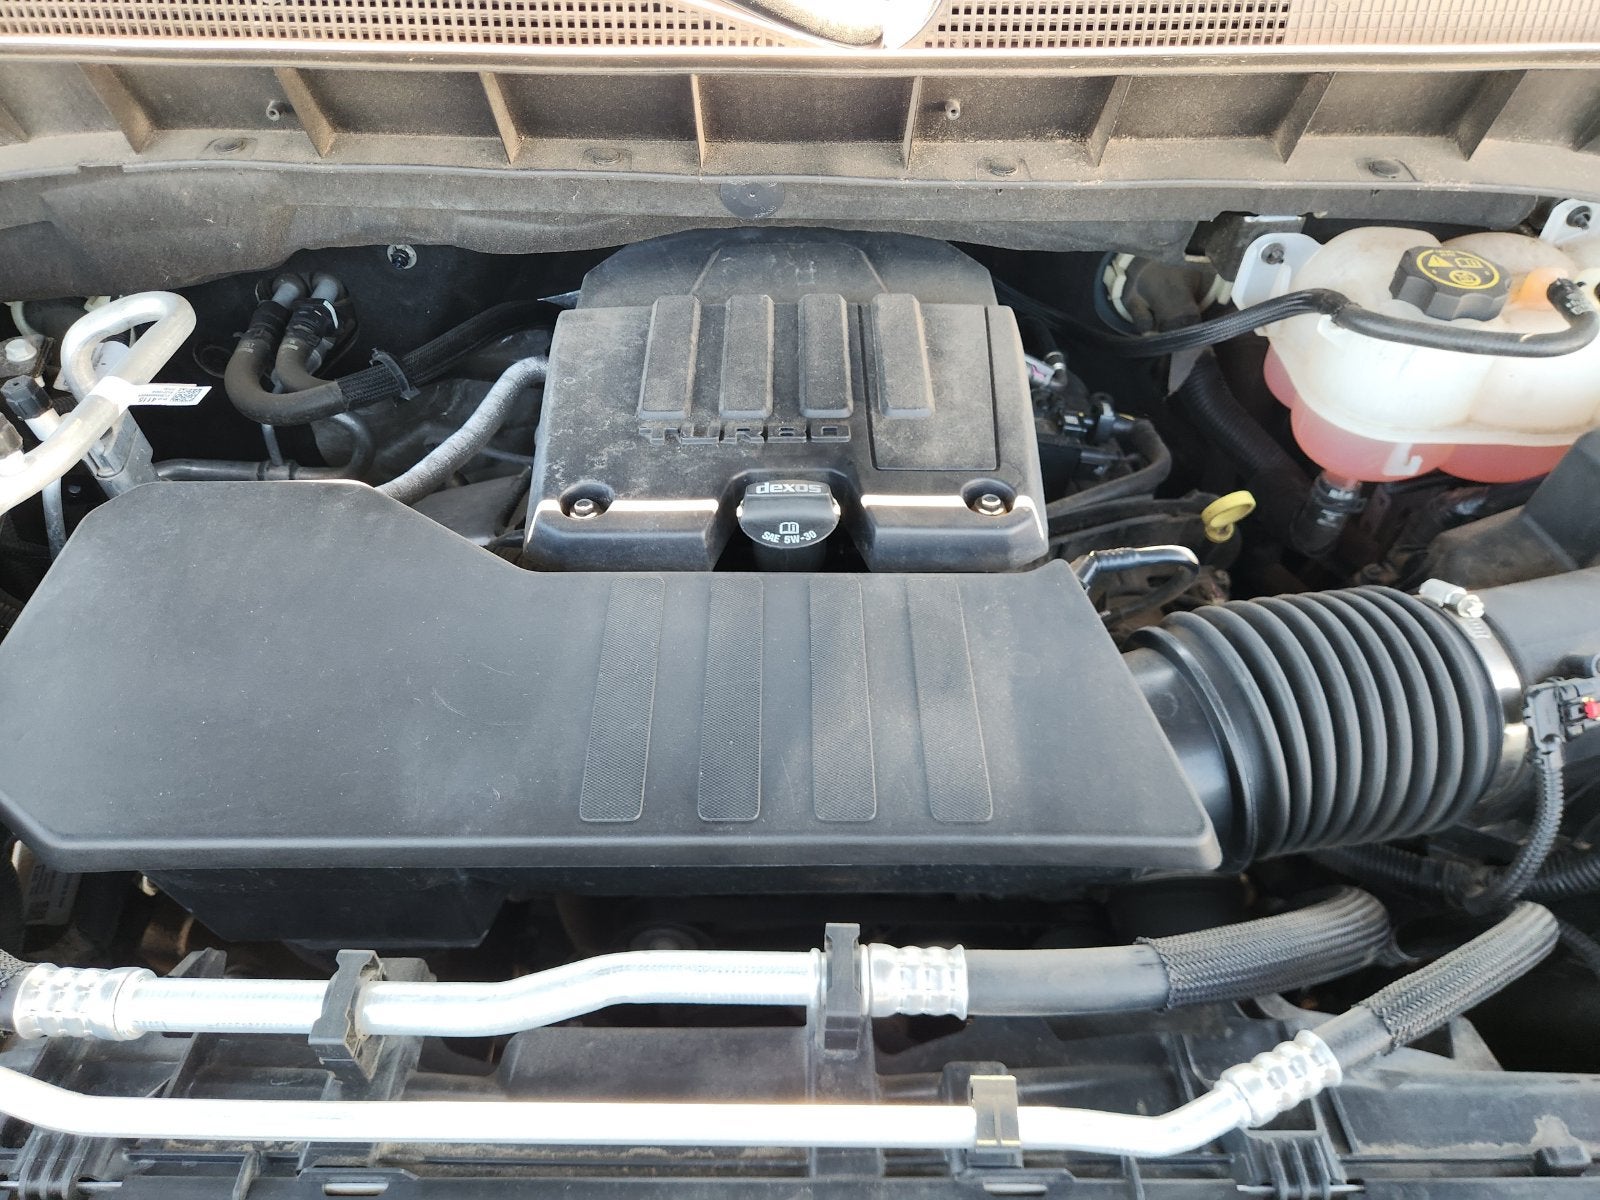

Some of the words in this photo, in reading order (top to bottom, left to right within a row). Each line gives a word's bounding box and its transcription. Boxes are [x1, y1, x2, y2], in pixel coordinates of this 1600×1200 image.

[638, 423, 852, 444] TURBO
[755, 482, 822, 494] dexos
[761, 531, 781, 543] SAE
[783, 530, 817, 544] 5W-30
